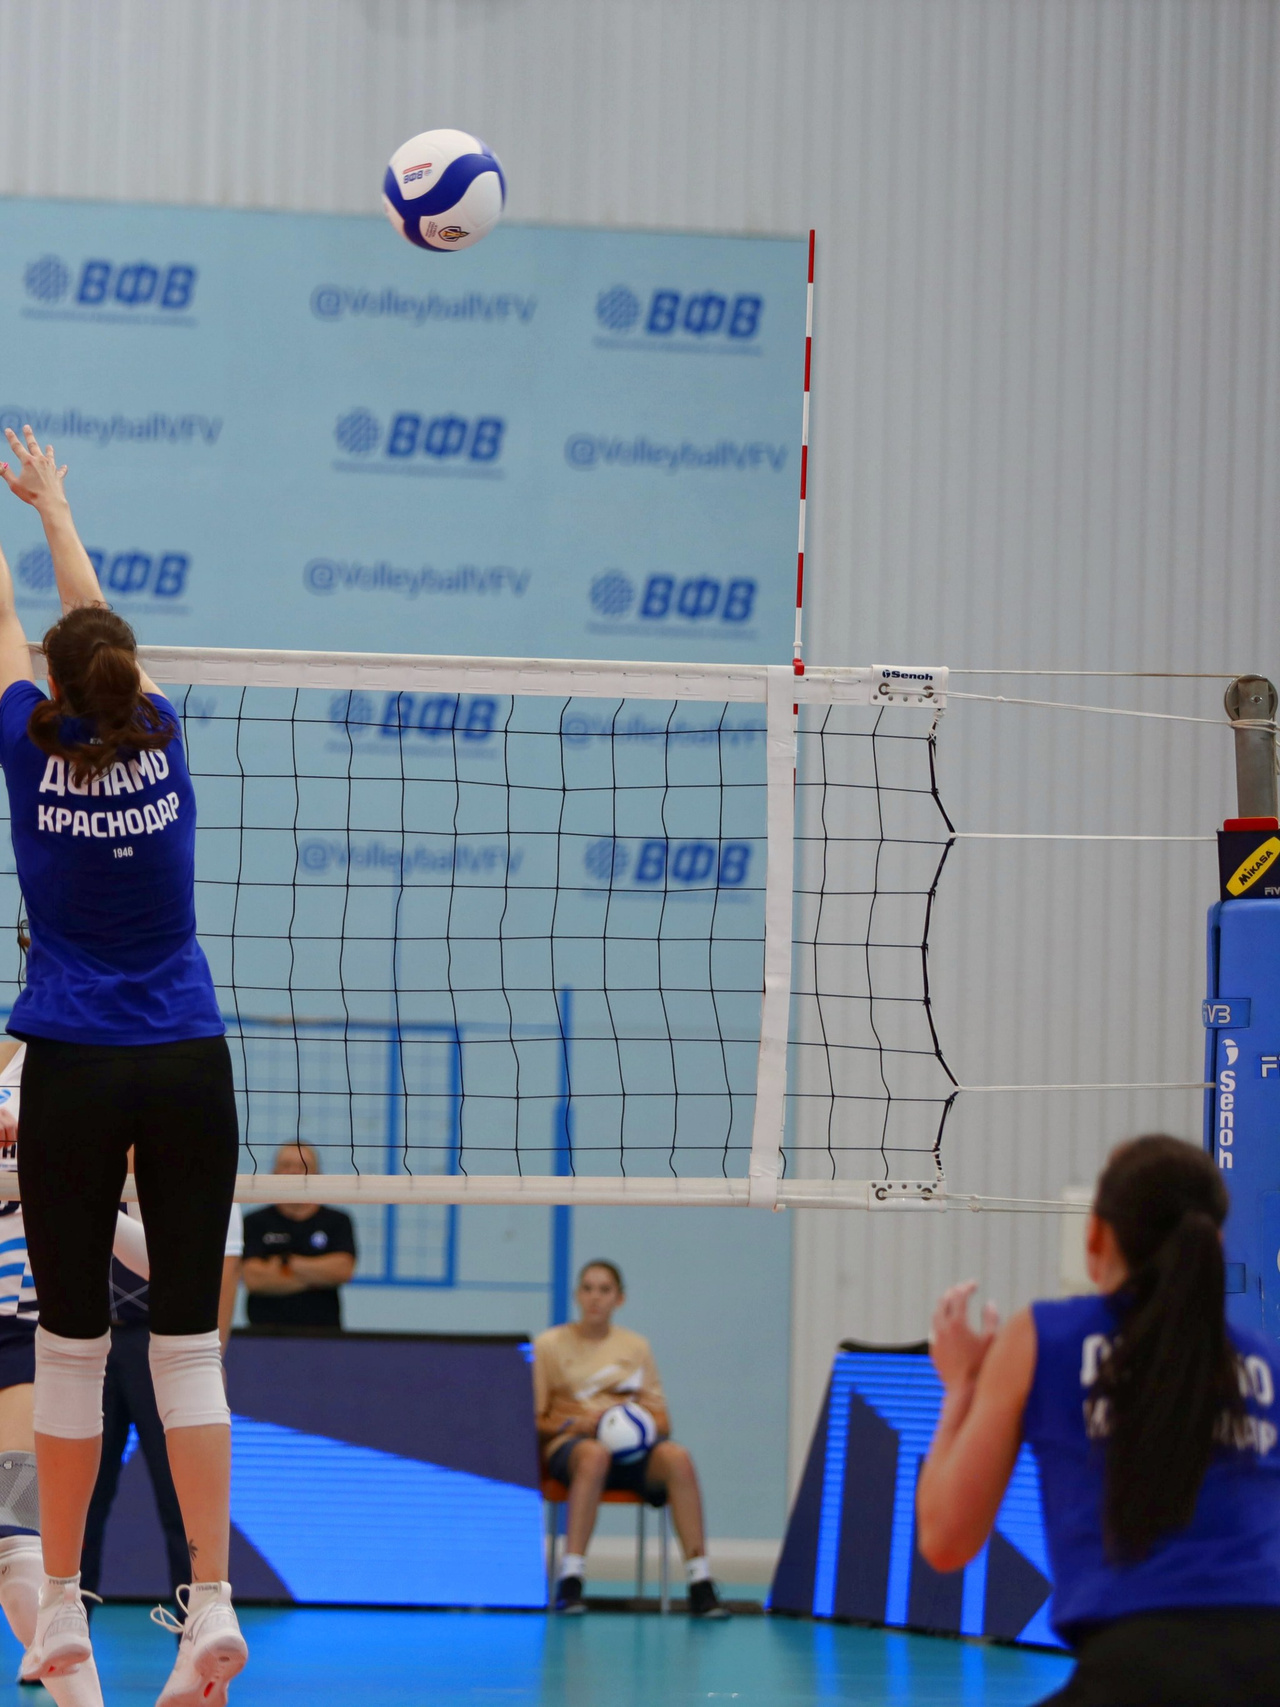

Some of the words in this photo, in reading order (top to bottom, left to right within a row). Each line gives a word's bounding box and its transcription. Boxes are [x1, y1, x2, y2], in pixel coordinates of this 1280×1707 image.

[76, 259, 198, 310] ВФВ
[646, 290, 764, 340] ВФВ
[385, 411, 507, 464] ВФВ
[639, 574, 759, 624] ВФВ
[891, 670, 933, 681] Senoh
[380, 693, 498, 741] ВФВ
[38, 791, 180, 838] КРАСНОДАР
[113, 847, 134, 858] 1946
[634, 840, 752, 886] ВФВ
[1219, 1070, 1236, 1169] Senoh
